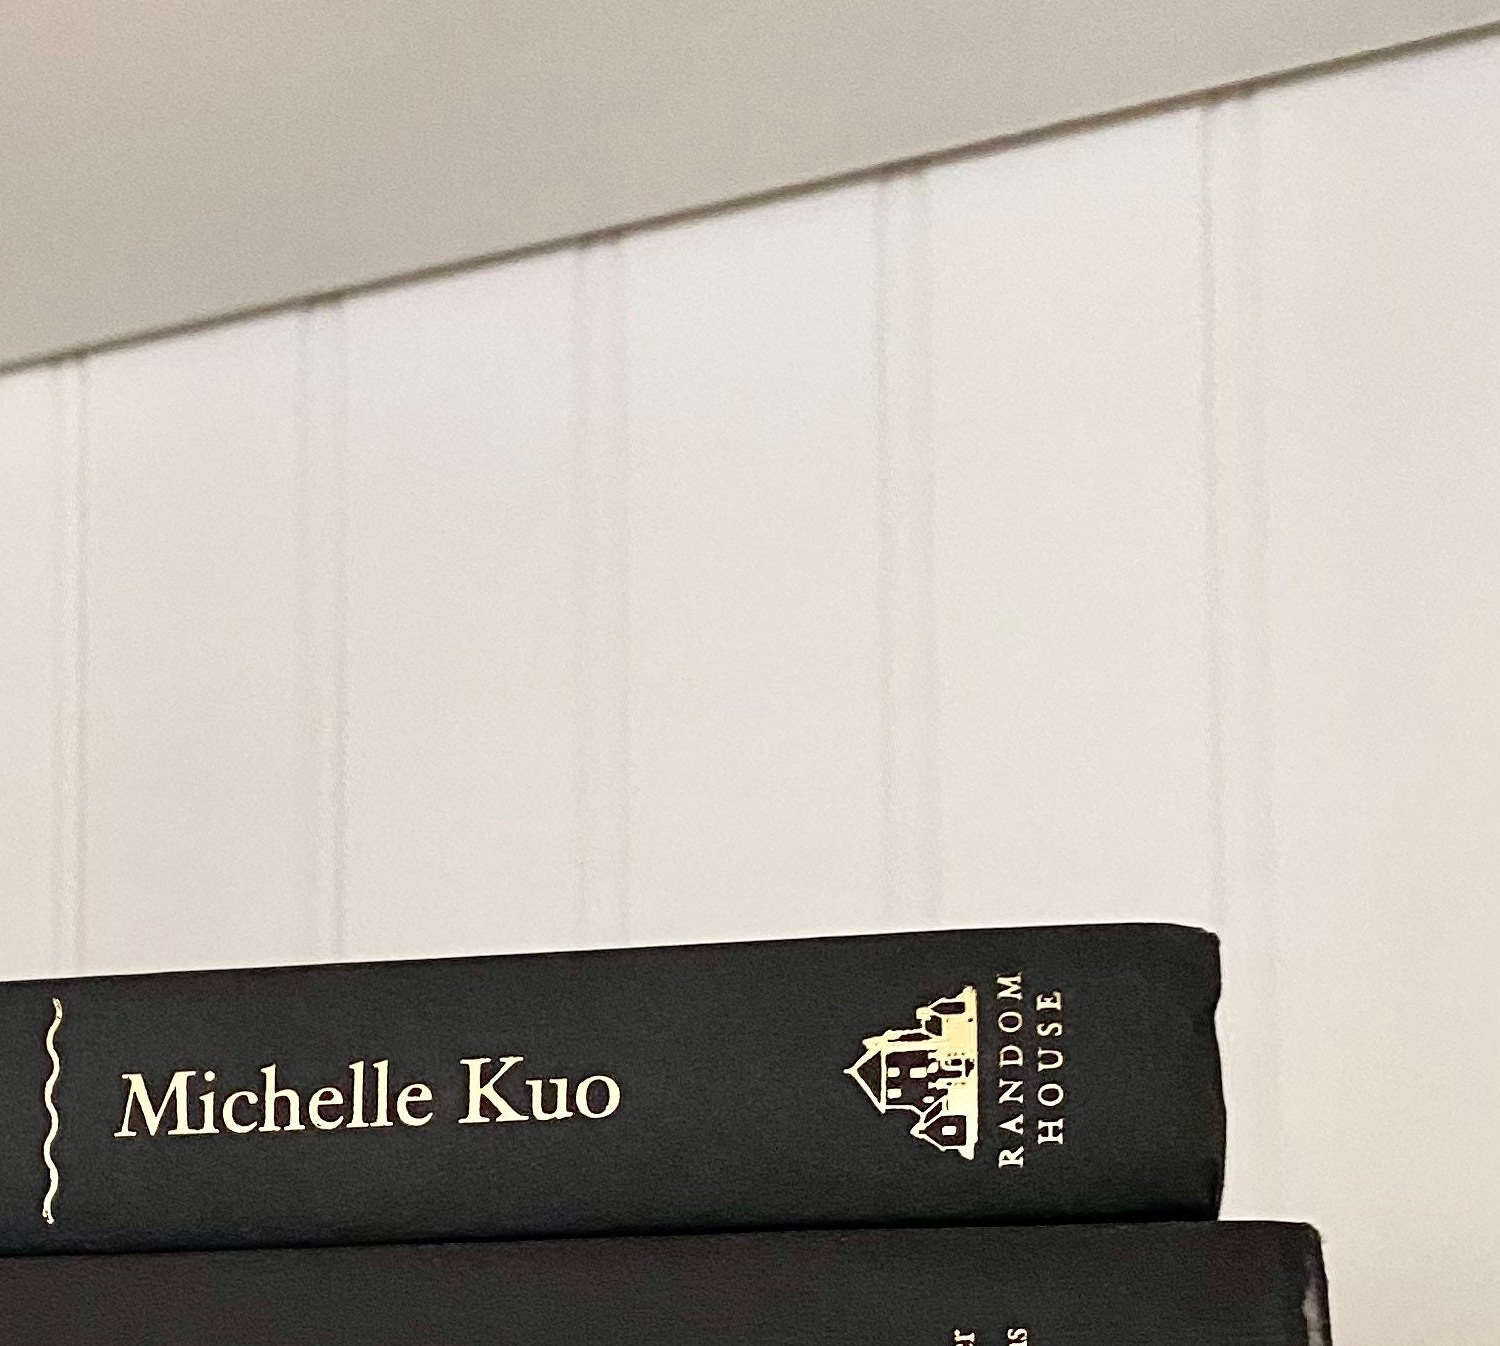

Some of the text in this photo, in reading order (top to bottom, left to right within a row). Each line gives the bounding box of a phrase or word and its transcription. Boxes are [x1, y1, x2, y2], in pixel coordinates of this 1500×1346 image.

[114, 1056, 620, 1137] Michelle Kuo
[997, 973, 1025, 1168] RANDOM
[1036, 991, 1064, 1145] HOUSE
